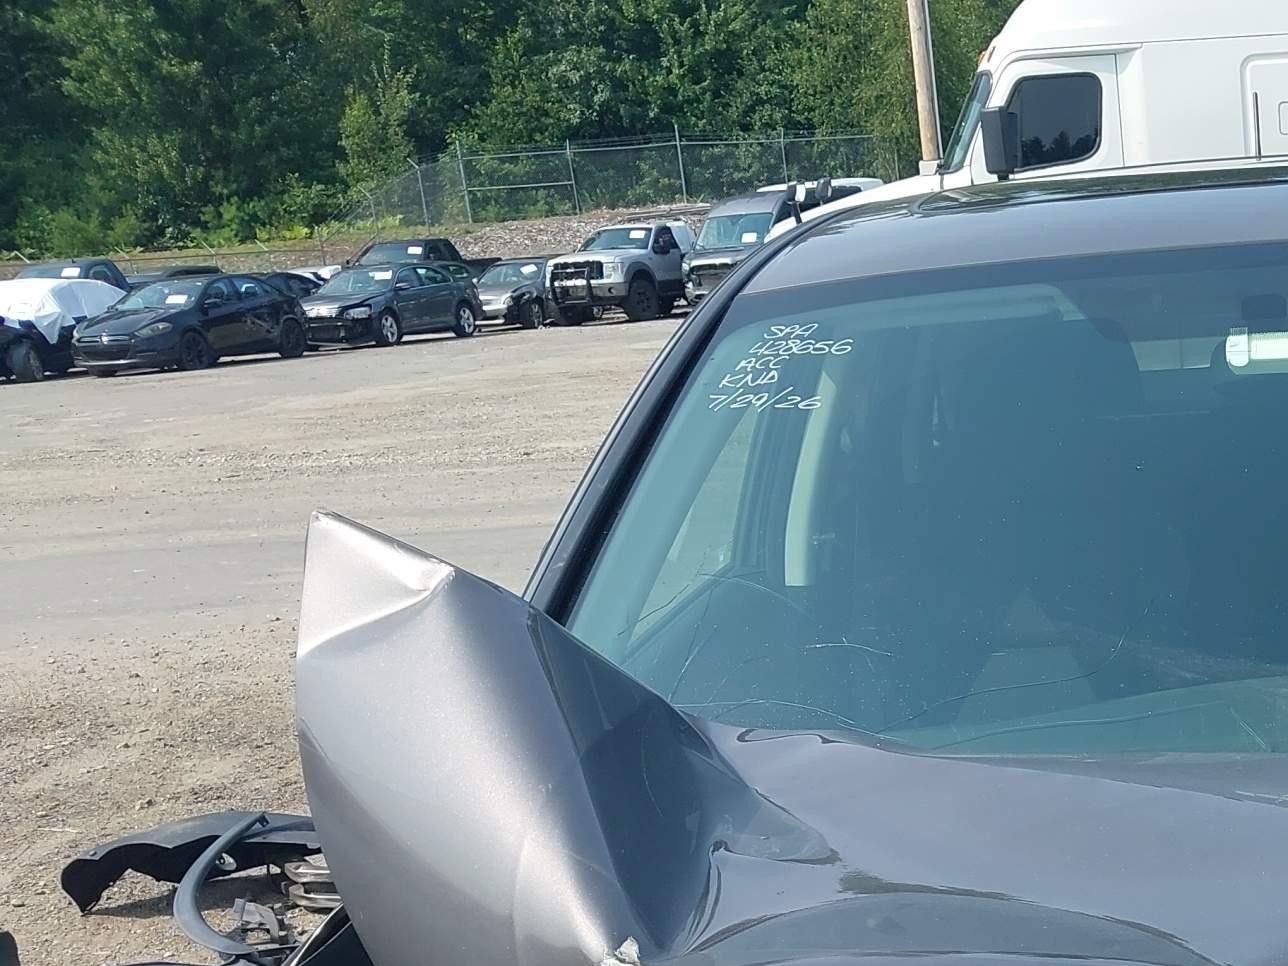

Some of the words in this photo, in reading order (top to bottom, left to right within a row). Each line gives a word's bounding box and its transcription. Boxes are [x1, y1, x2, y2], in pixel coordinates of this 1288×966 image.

[748, 338, 854, 356] 428656
[735, 355, 790, 372] ACC
[708, 386, 823, 412] 7/29/26
